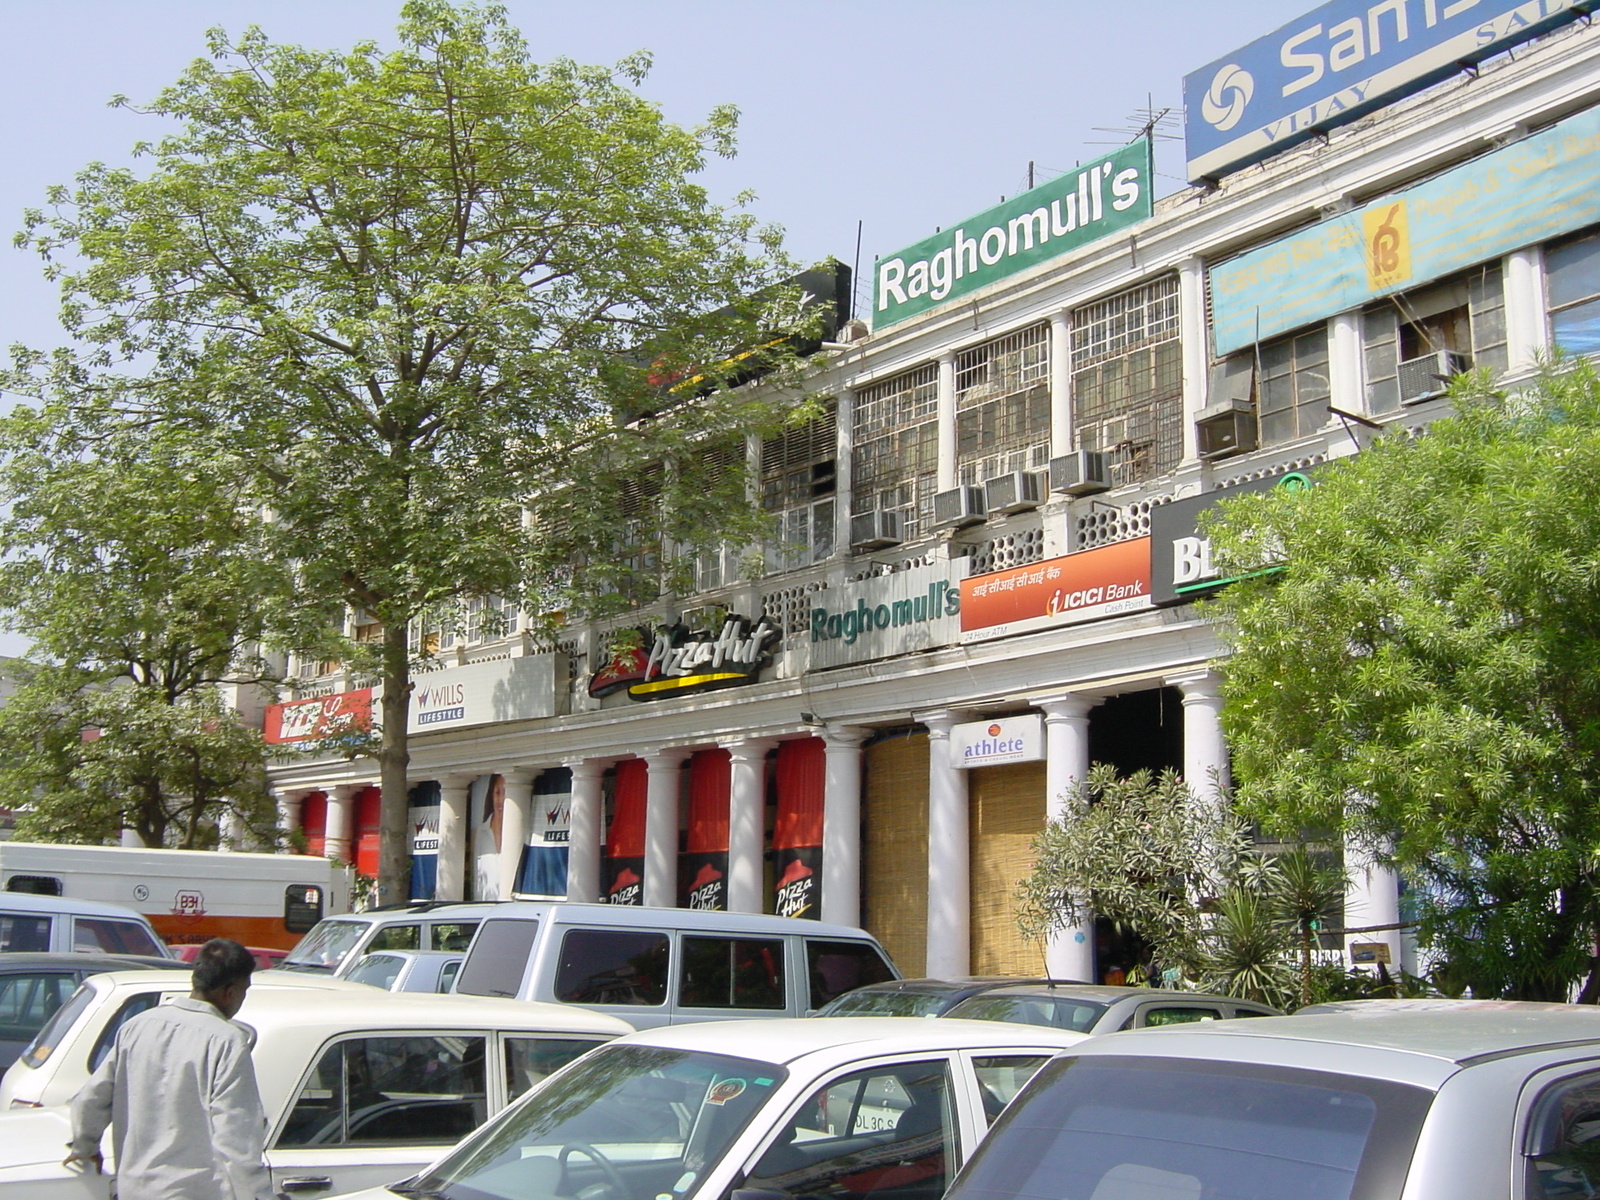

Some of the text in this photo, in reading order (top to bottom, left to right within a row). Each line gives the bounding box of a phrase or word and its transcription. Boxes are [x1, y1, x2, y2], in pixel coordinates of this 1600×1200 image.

[1262, 0, 1582, 142] VIJAY SAL
[878, 161, 1140, 312] Raghomull's
[1063, 586, 1104, 609] ICICI
[1105, 579, 1143, 601] Bank
[811, 578, 960, 645] Raghomull's
[1104, 600, 1144, 614] Cash Point
[991, 626, 1008, 637] ATM
[644, 620, 774, 682] Pizza Hut
[430, 684, 464, 707] WILLS
[420, 708, 462, 724] LIFESTYLE
[964, 738, 1024, 757] athlete
[415, 840, 438, 850] LIFEST
[547, 831, 570, 842] LIFES
[689, 881, 722, 909] Pizza
[775, 878, 813, 914] Pizza
[781, 894, 810, 918] Hut
[871, 1117, 884, 1131] 3C
